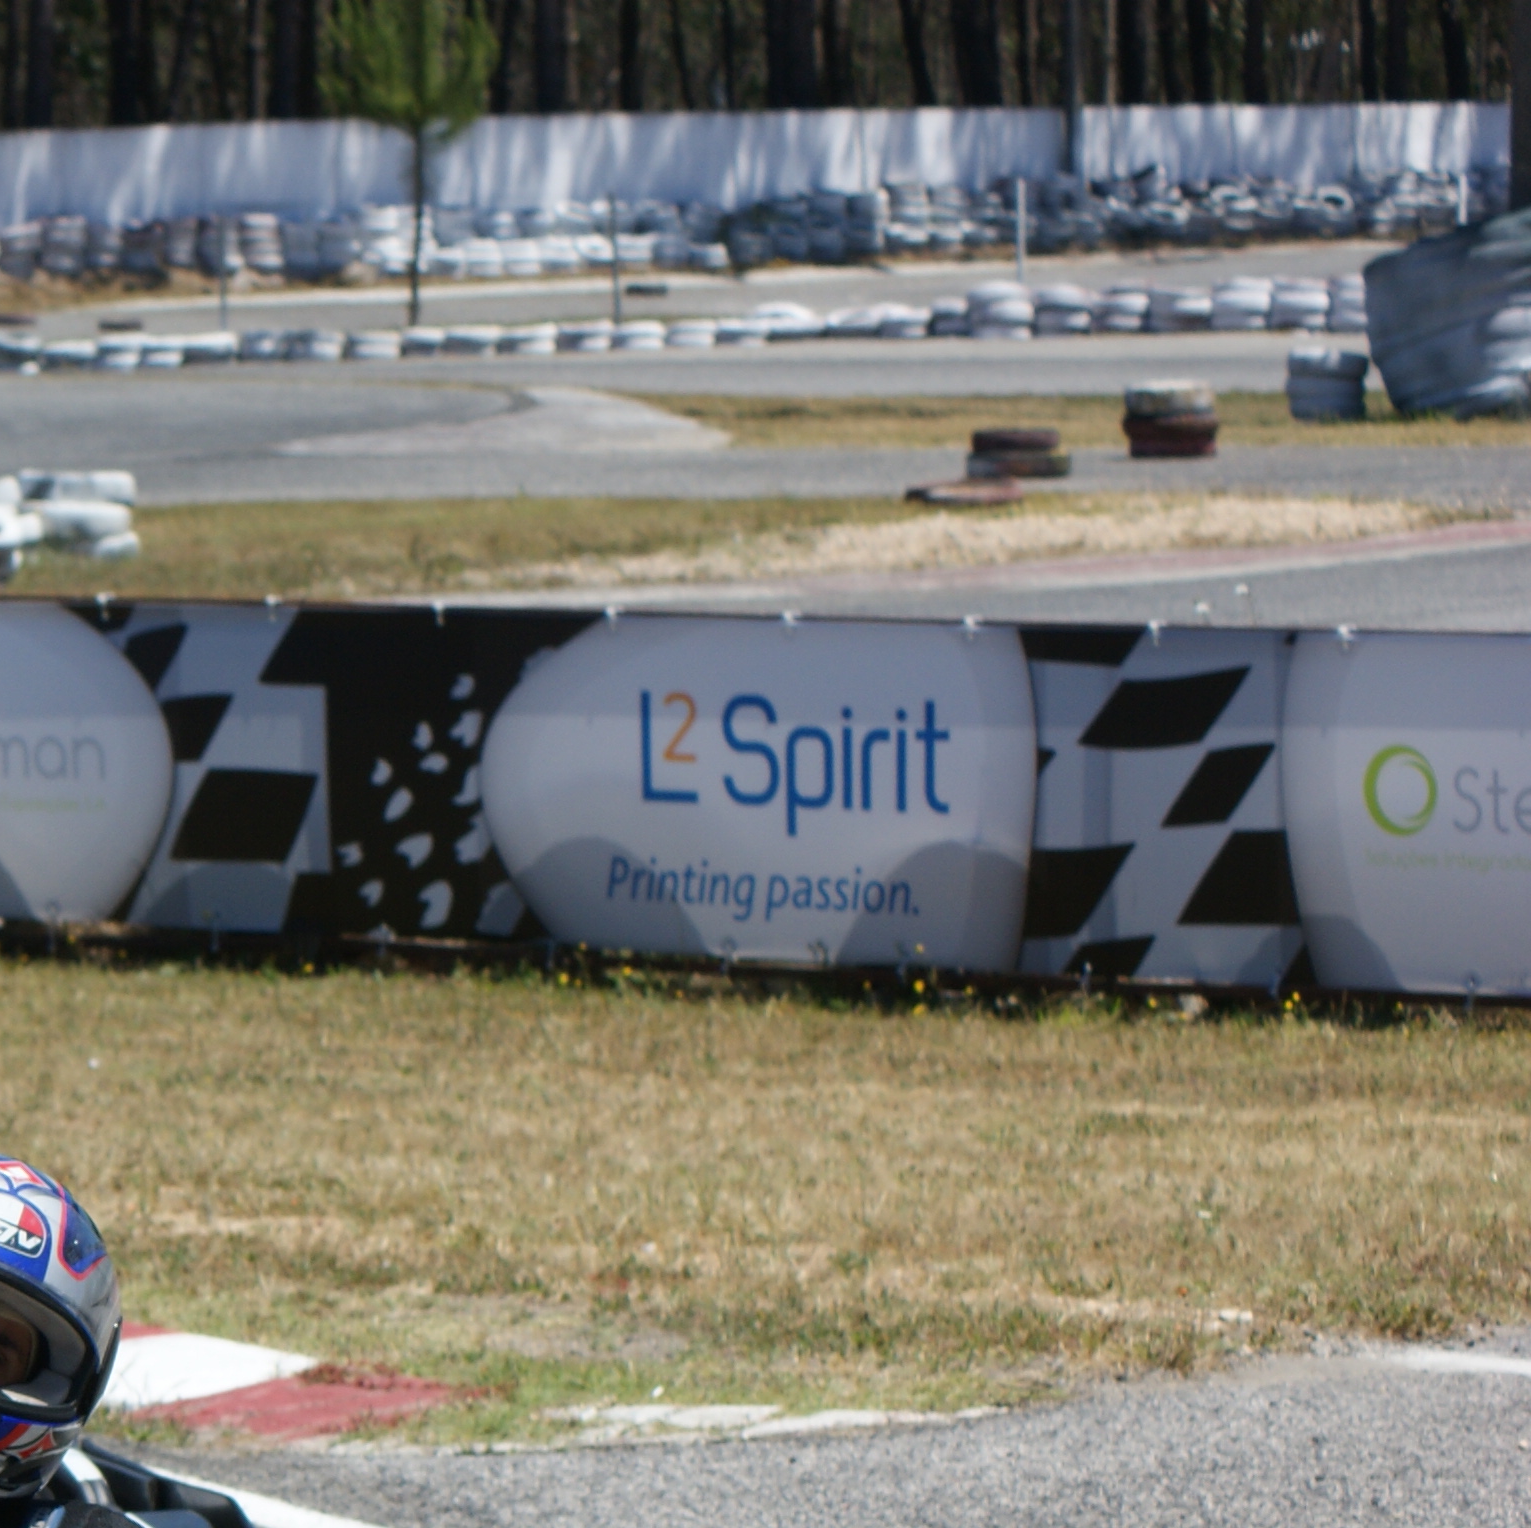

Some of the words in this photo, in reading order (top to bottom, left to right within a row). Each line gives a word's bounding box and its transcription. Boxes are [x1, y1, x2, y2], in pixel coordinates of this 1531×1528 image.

[722, 694, 951, 837] Spirit
[606, 856, 756, 922] Printing
[764, 866, 920, 922] passion.
